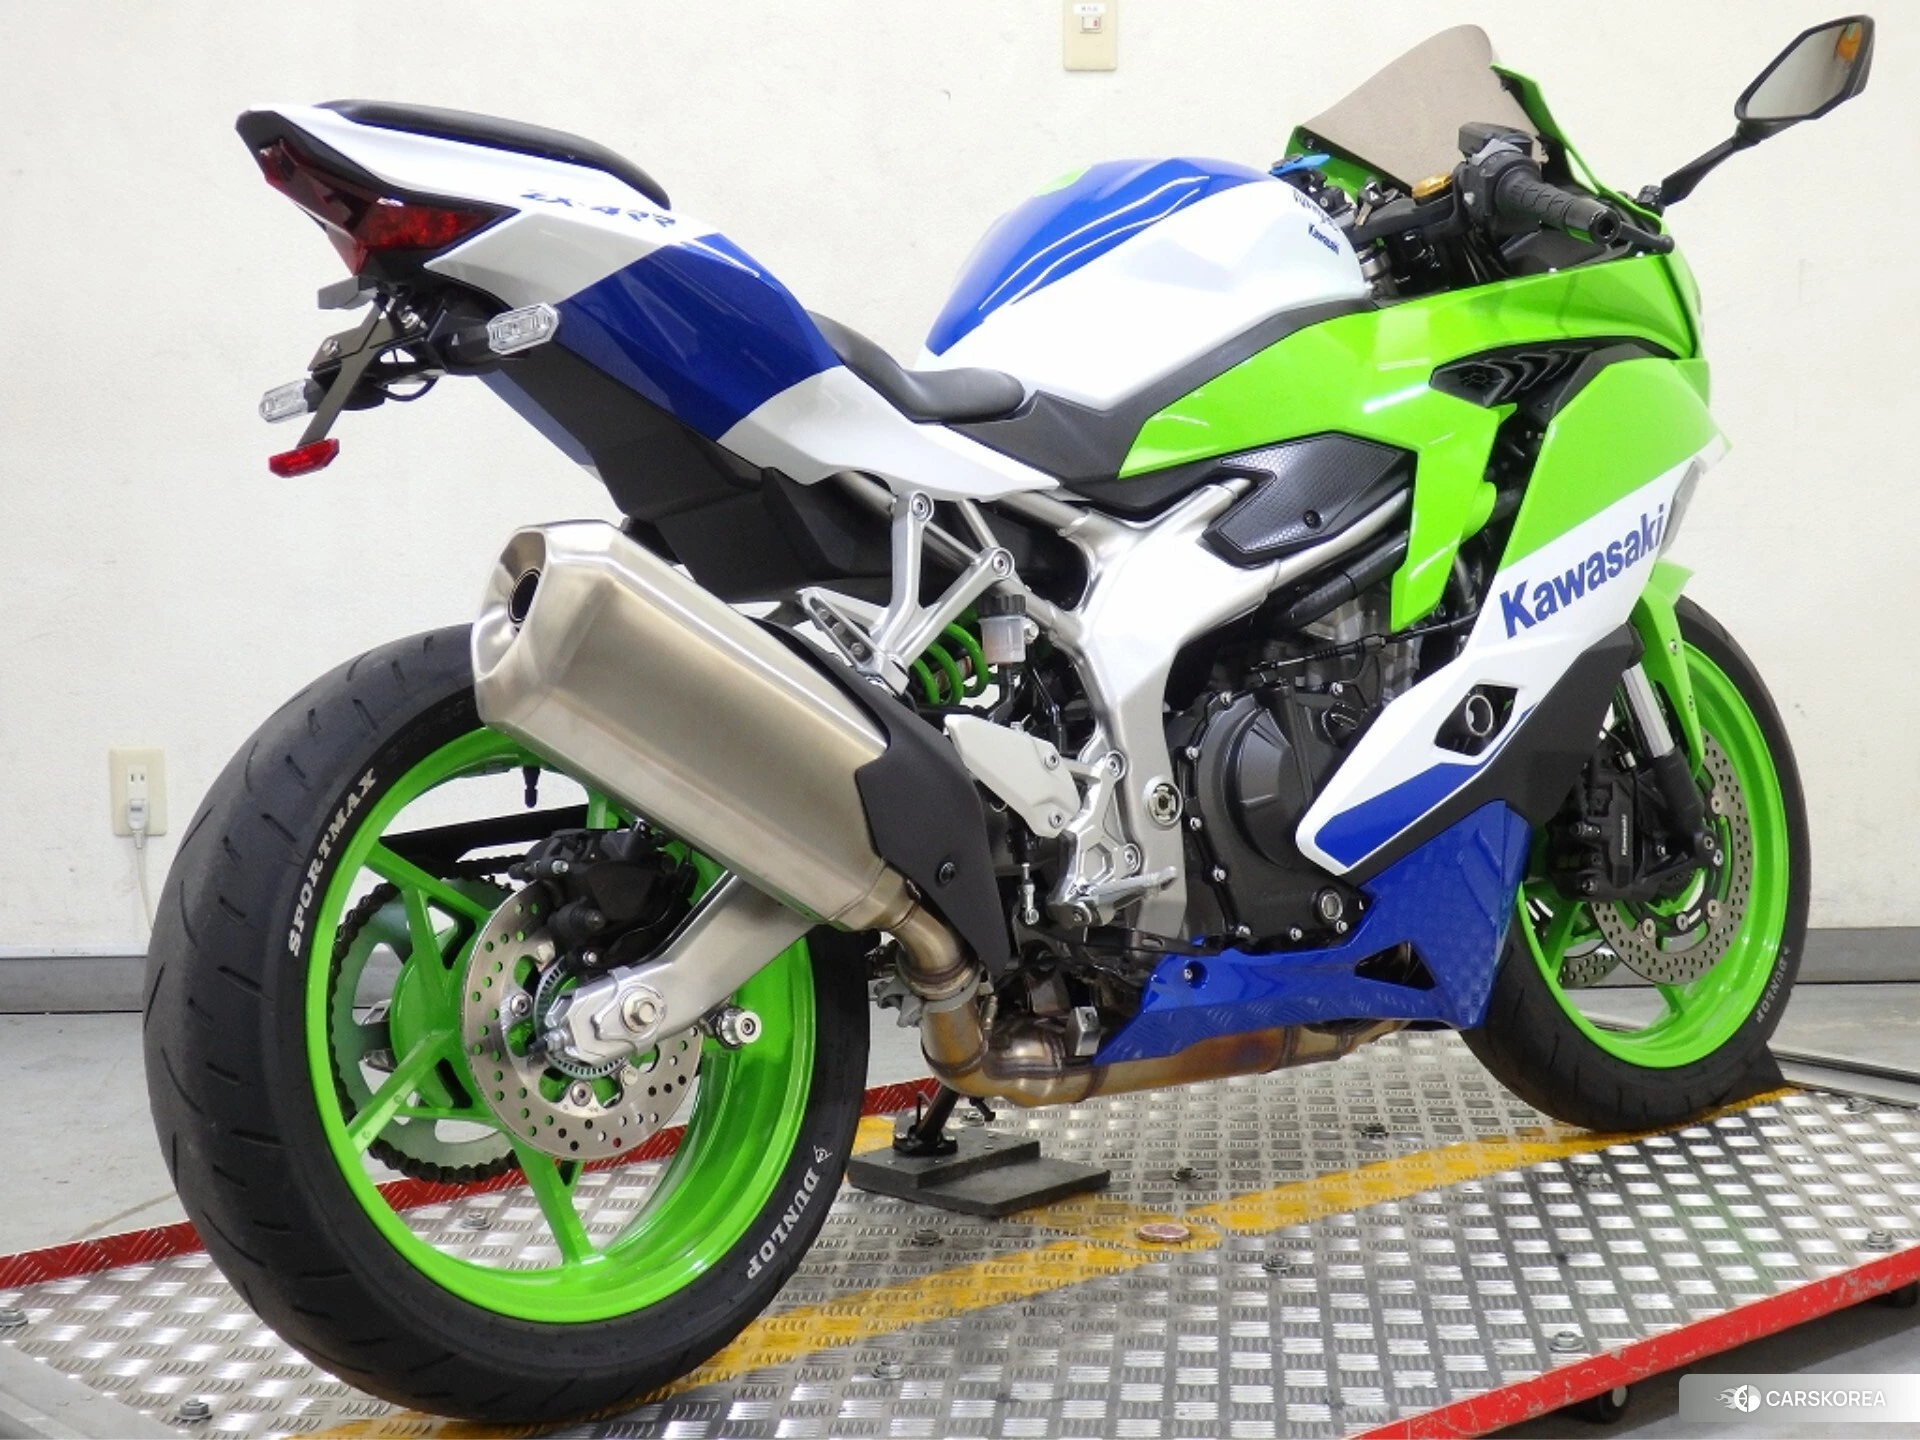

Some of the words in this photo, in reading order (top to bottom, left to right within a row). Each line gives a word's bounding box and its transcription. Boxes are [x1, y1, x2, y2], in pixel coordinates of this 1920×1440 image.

[1500, 503, 1665, 639] Kawasaki
[288, 767, 377, 957] SPORTMAX
[1756, 956, 1788, 1023] DUNLOP
[747, 1167, 820, 1280] DUNLOP
